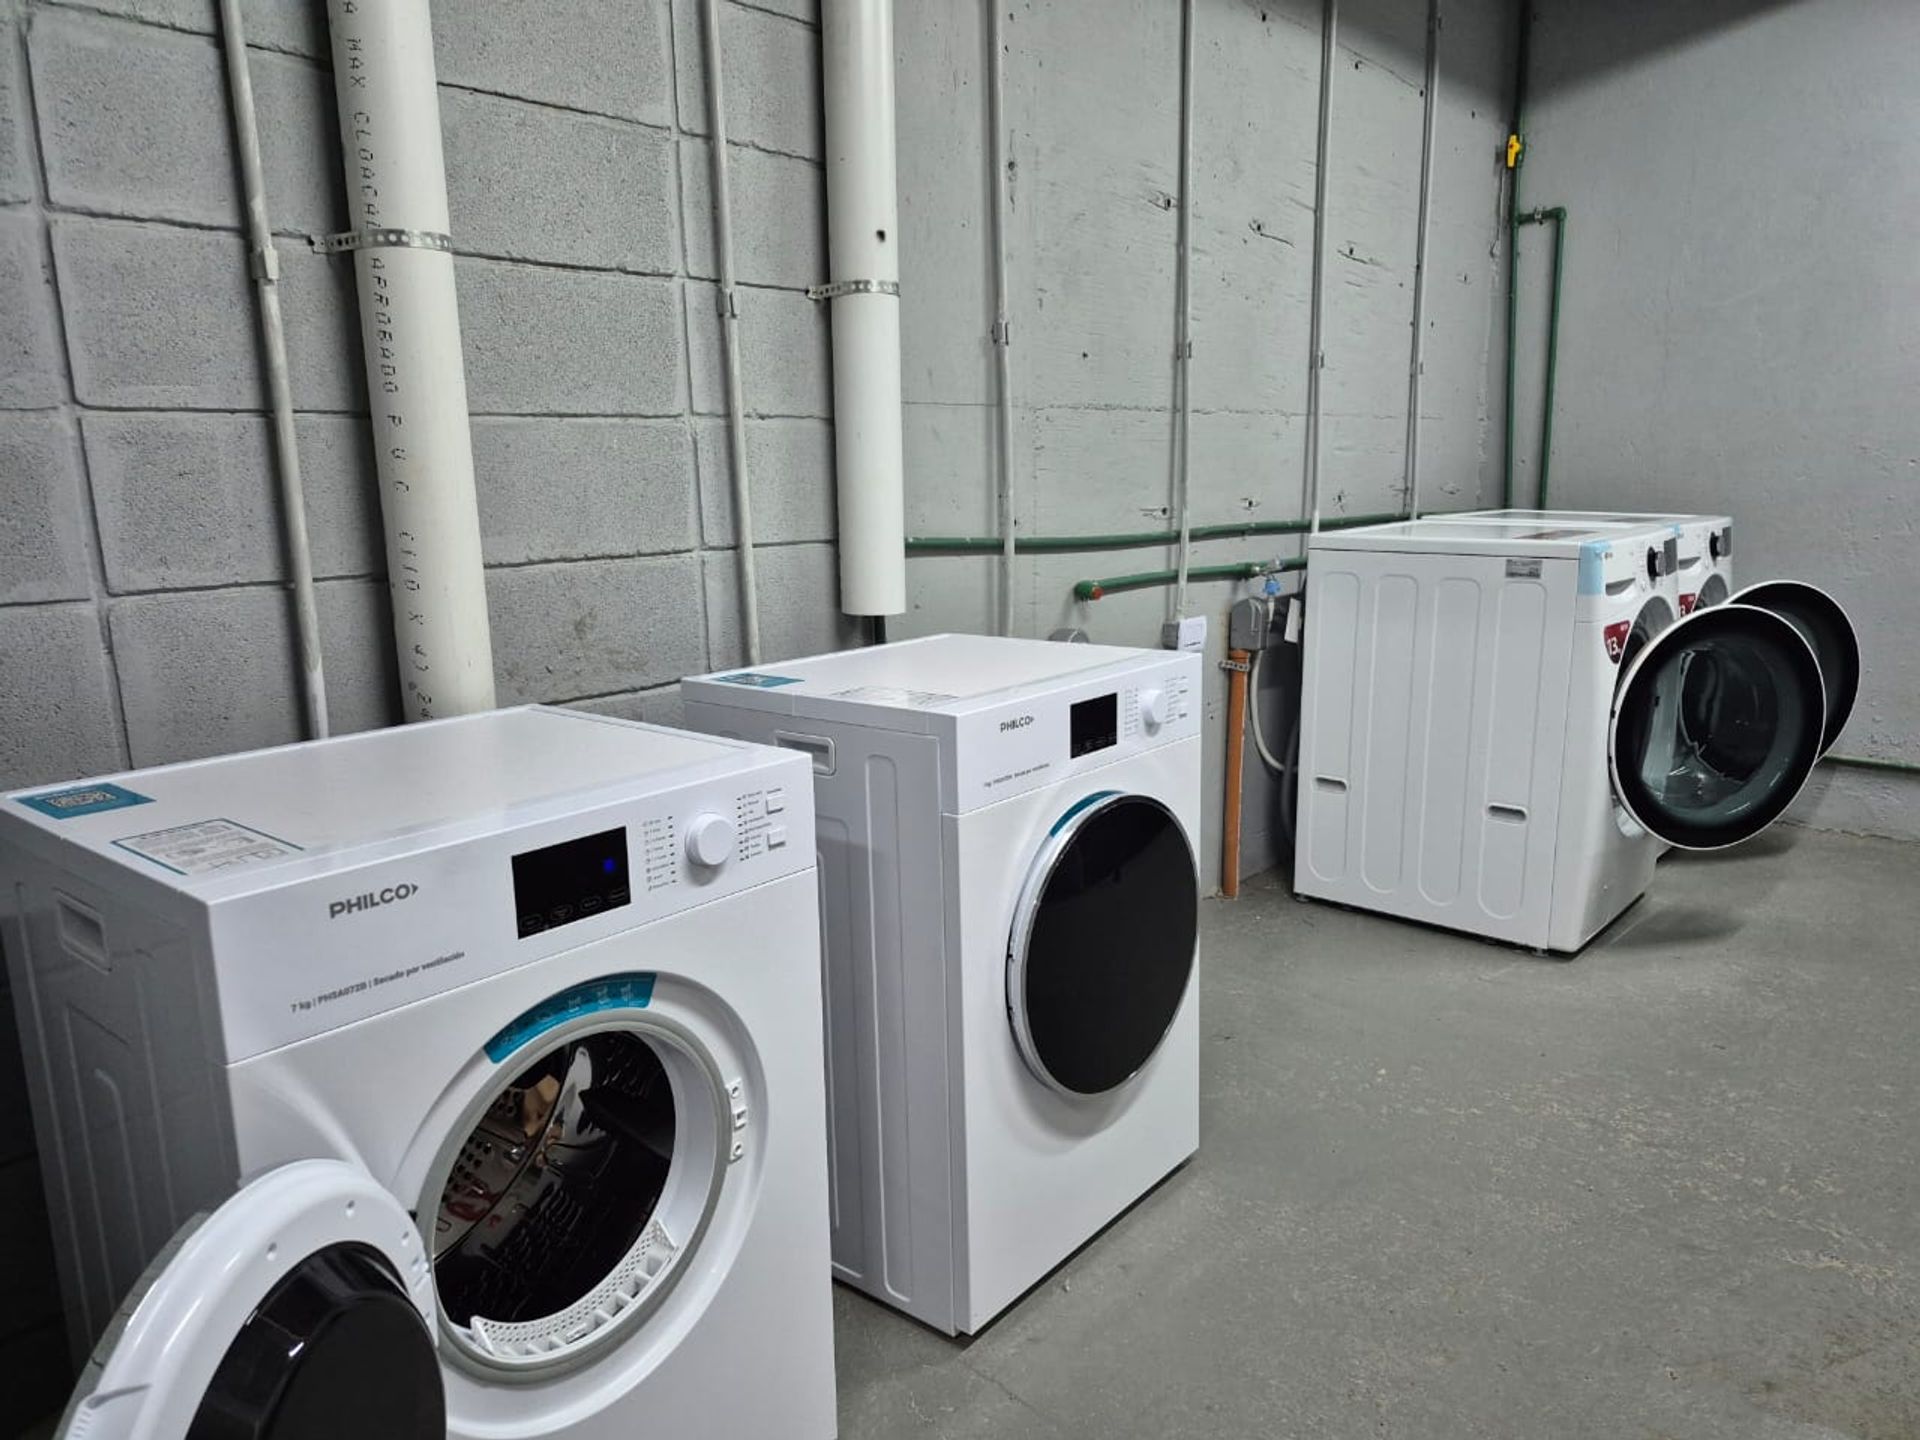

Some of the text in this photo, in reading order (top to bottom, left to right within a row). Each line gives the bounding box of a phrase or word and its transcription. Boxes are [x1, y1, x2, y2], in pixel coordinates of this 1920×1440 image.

[346, 37, 366, 88] MAX
[353, 110, 382, 230] CLOACAL
[370, 256, 399, 394] APROBADO
[1000, 715, 1031, 732] PHILCO
[329, 884, 411, 919] PHILCO
[373, 969, 405, 987] Secado
[405, 966, 421, 978] por
